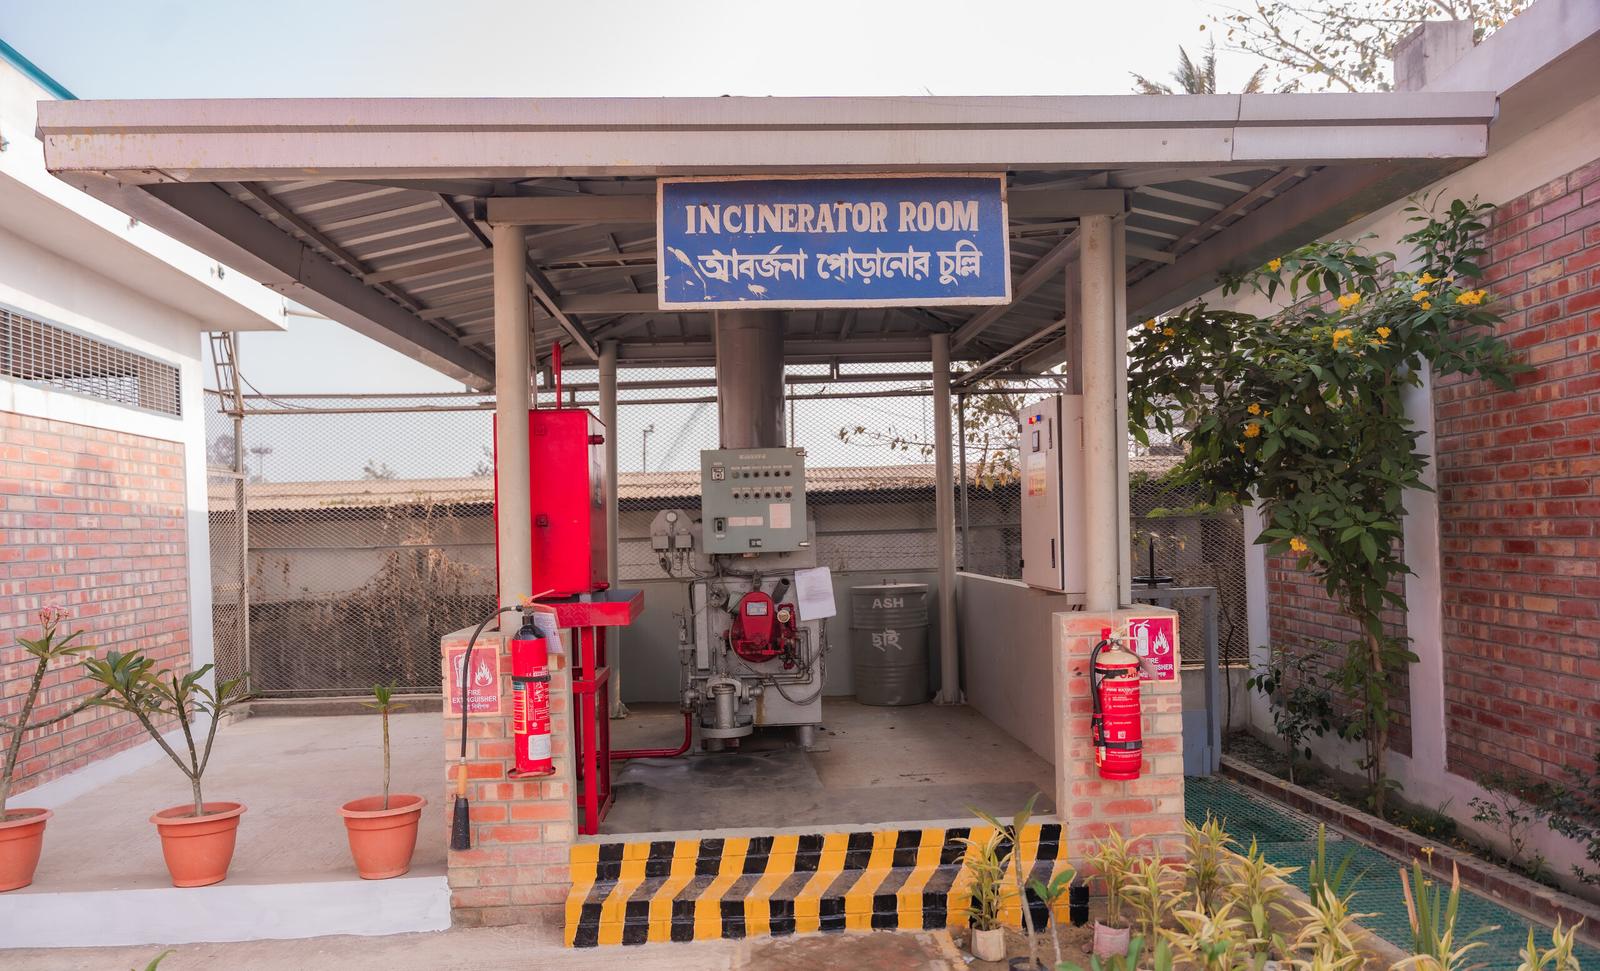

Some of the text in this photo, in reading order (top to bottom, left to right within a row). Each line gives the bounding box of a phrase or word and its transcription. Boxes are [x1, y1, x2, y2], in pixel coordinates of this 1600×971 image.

[685, 200, 979, 234] INCINERATOR ROOM
[697, 239, 983, 286] আবর্জনা পোড়ানোর চুল্লি
[872, 597, 904, 609] ASH
[871, 628, 903, 652] ছাই
